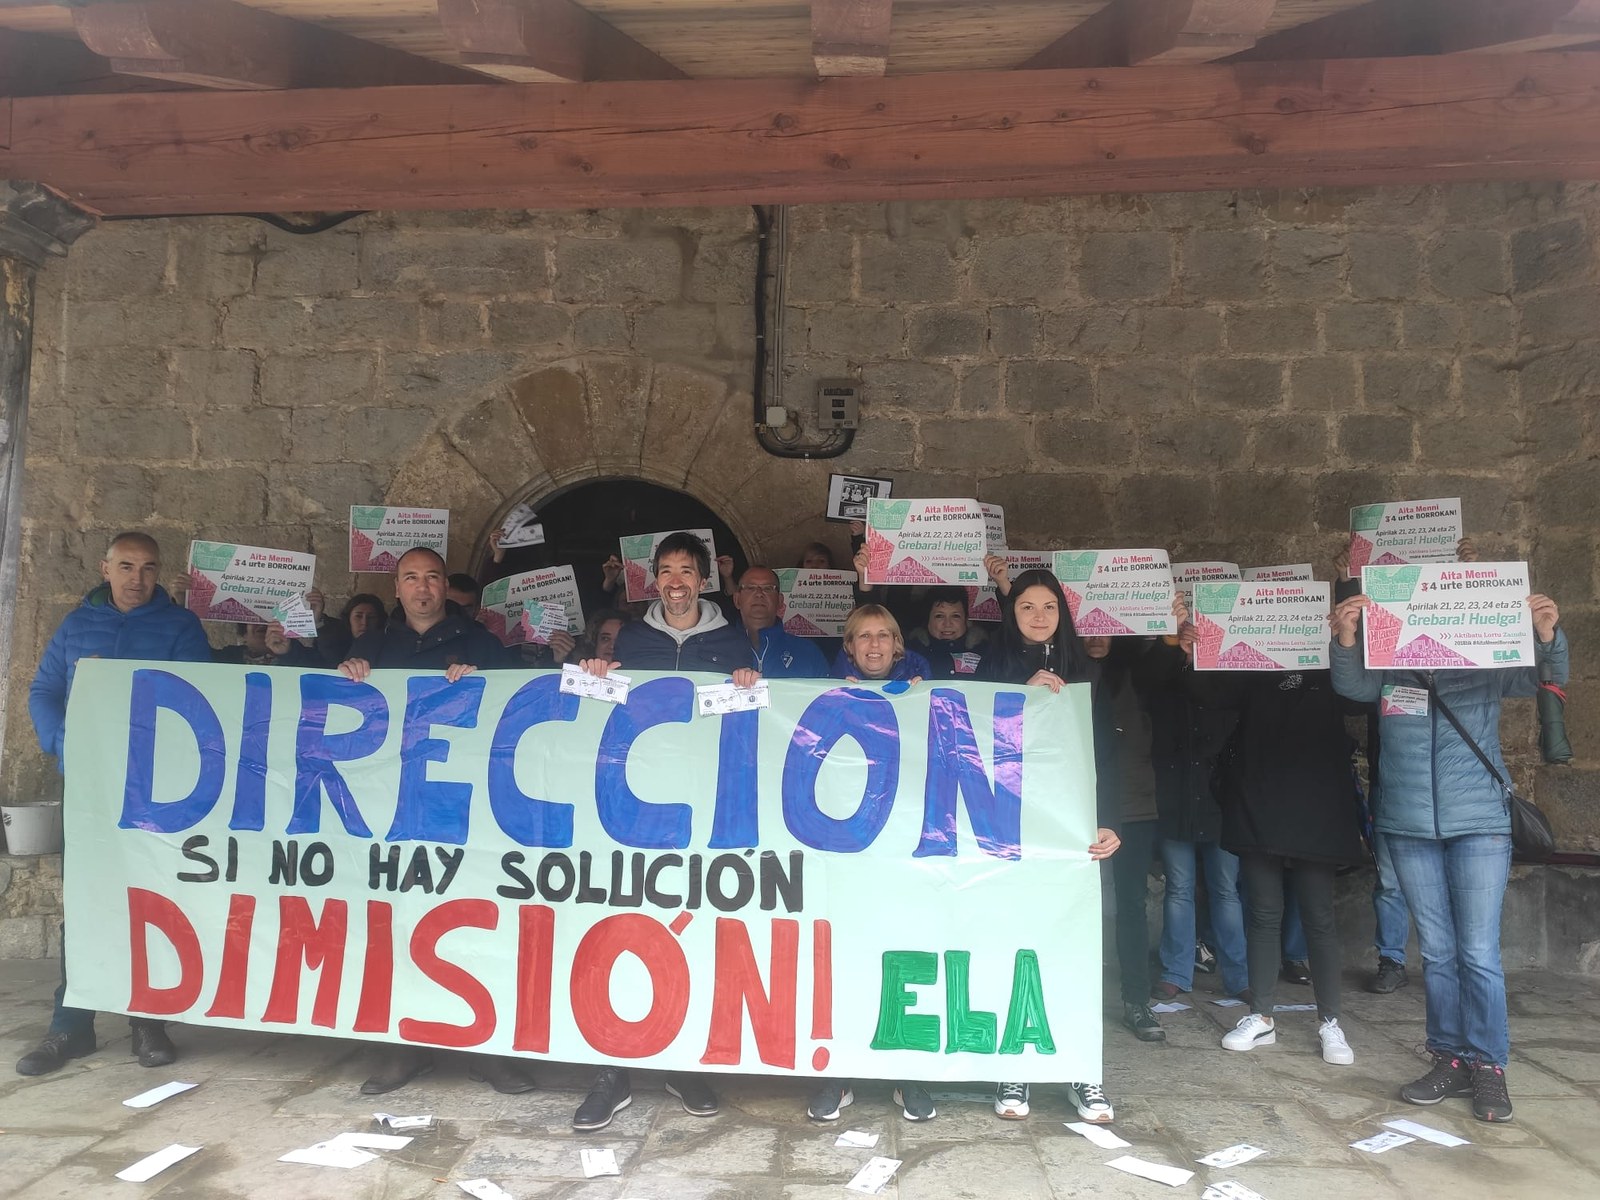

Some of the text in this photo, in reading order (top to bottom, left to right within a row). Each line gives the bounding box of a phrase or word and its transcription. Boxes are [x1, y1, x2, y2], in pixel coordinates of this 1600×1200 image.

[924, 504, 966, 514] Aita Menni
[1416, 504, 1439, 512] Menni
[1416, 510, 1457, 519] BORROKAN!
[376, 538, 442, 548] Grebara! Huelga!
[1376, 534, 1456, 547] Grebara! Huelga!
[898, 540, 982, 552] Grebara! Huelga!
[250, 552, 294, 563] Aita Menni
[1130, 554, 1153, 563] Menni
[268, 562, 310, 572] BORROKAN!
[1130, 562, 1168, 571] BORROKAN!
[221, 573, 245, 582] Apirilak
[522, 571, 556, 585] Aita Menni
[958, 572, 978, 580] ELA
[1272, 569, 1293, 577] Menni
[1440, 569, 1498, 580] Aita Menni
[537, 575, 572, 588] BORROKAN!
[1440, 582, 1462, 590] urte
[1466, 578, 1524, 589] BORROKAN!
[220, 582, 305, 598] Grebara! Huelg!
[1276, 587, 1304, 596] Menni
[1086, 590, 1170, 602] Grebara! Huelga!
[1276, 595, 1325, 604] BORROKAN!
[789, 601, 855, 611] Grebara! Huelga!
[1406, 602, 1438, 612] Apirilak
[1440, 602, 1451, 610] 21,
[1453, 602, 1466, 610] 22,
[1468, 602, 1480, 610] 23,
[1147, 620, 1167, 628] ELA
[1407, 612, 1522, 627] Grebara! Huelga!
[1228, 624, 1322, 636] Grebara! Huelga!
[1493, 650, 1521, 660] ELA
[117, 668, 1027, 861] DIRECCIÓN
[177, 835, 804, 912] SI NO HAY SOLUCIÓN
[127, 886, 833, 1071] DIMISIÓN!
[869, 949, 1057, 1055] ELA
